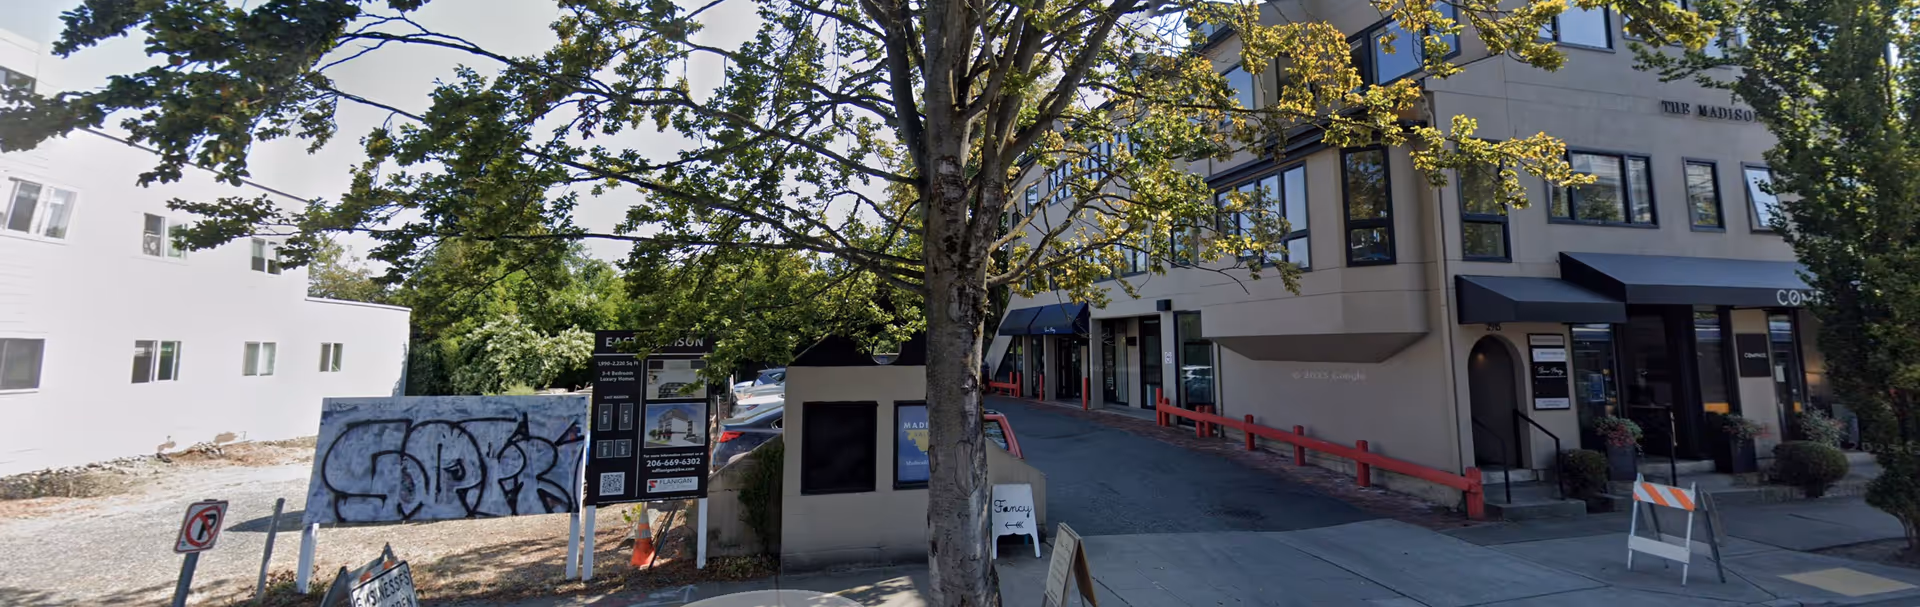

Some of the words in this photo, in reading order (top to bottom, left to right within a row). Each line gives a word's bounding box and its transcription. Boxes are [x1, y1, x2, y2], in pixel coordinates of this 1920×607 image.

[1661, 100, 1691, 114] THE
[646, 458, 701, 467] 206-669-6302
[993, 500, 1032, 518] Fancy
